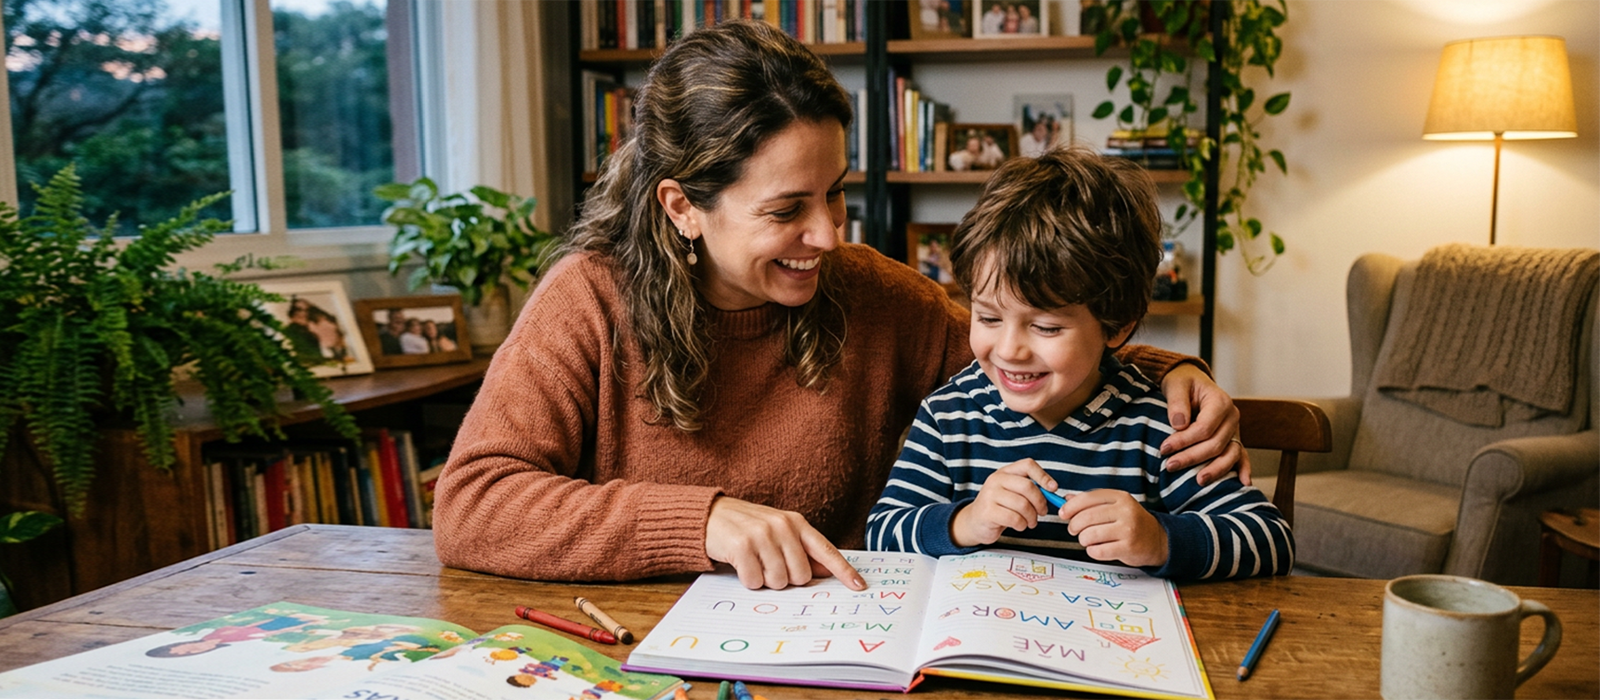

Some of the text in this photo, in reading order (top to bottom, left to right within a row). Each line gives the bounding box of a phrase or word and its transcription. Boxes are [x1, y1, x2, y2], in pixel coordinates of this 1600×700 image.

[951, 580, 1149, 613] CASA CASA
[712, 600, 735, 611] U
[753, 603, 778, 614] O
[879, 604, 901, 615] A
[972, 605, 1074, 630] AMOR
[669, 635, 885, 654] A E I O U
